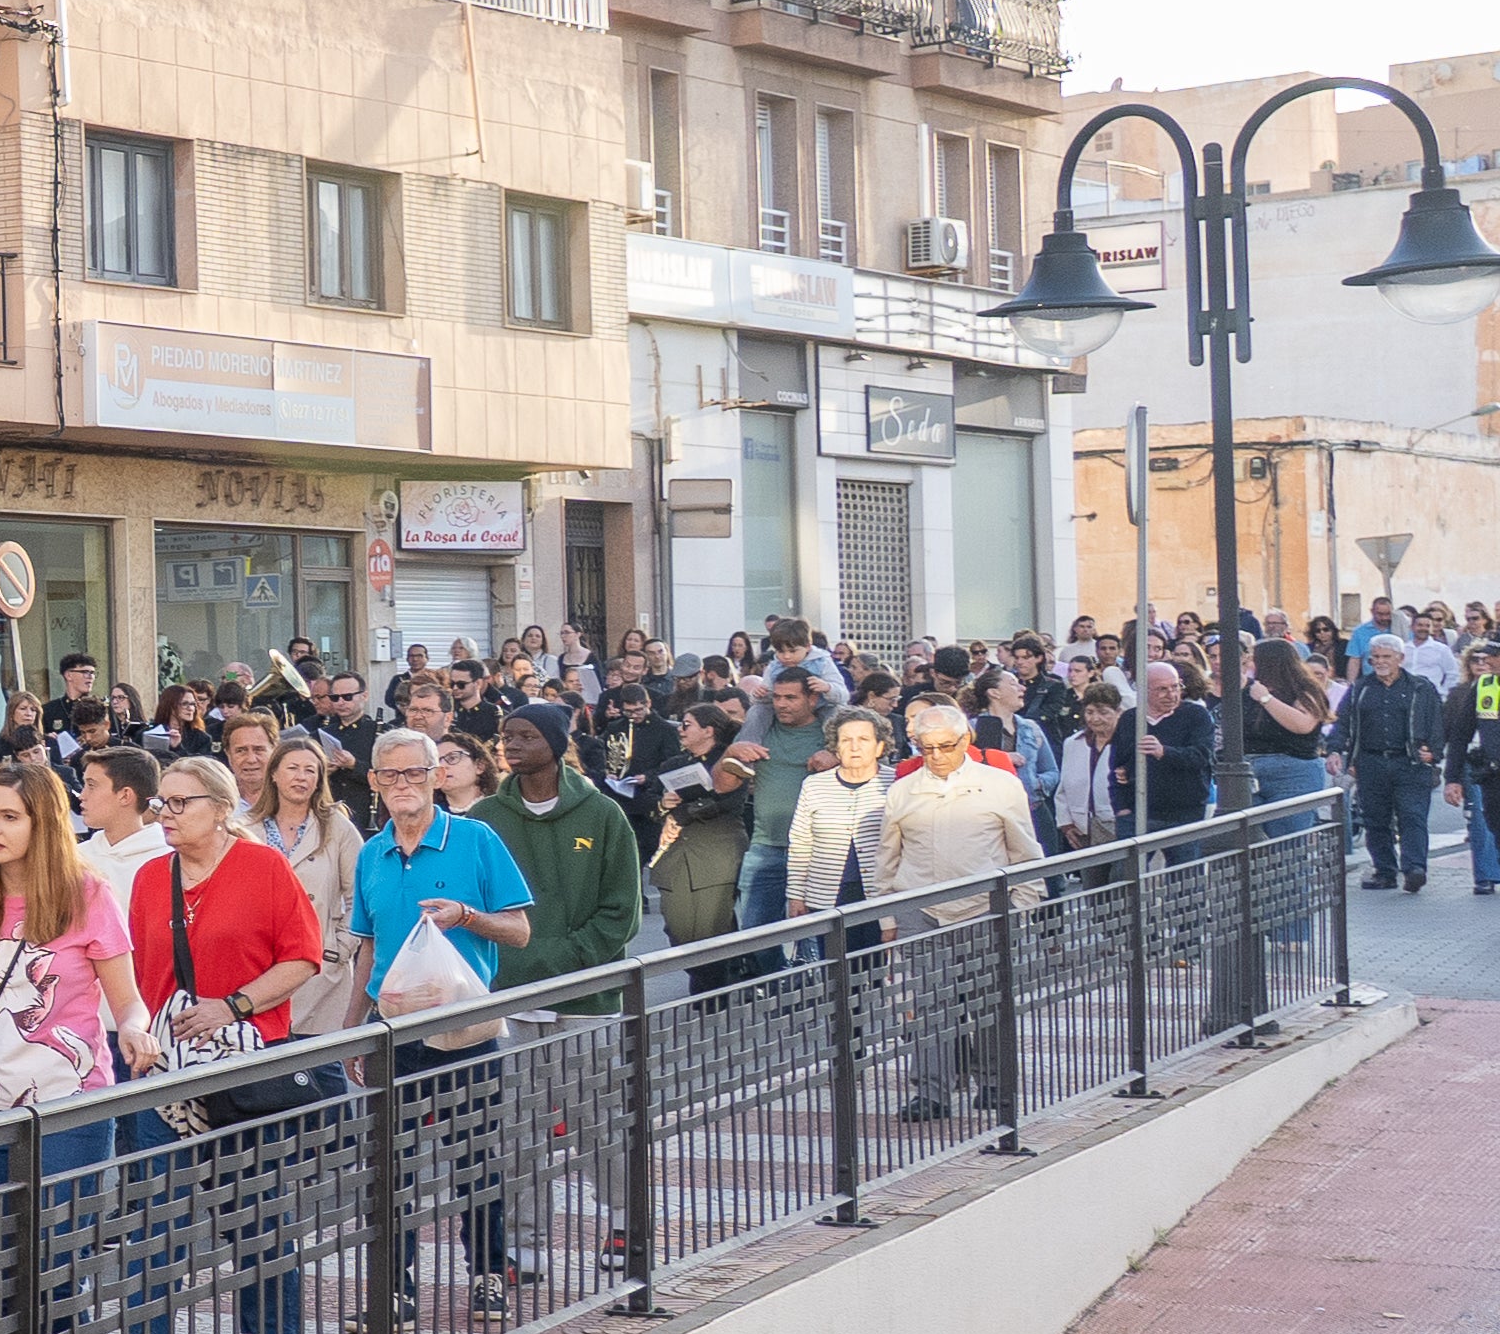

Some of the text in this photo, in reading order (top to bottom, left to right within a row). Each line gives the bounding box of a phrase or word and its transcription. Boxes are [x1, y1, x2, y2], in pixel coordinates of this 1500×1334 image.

[1095, 247, 1158, 263] RISLAW
[151, 345, 204, 371] PIEDAD
[208, 351, 272, 378] MORENO
[152, 390, 204, 413] Abogados
[215, 395, 272, 417] Mediadores
[405, 529, 519, 544] La Rosa de Coral
